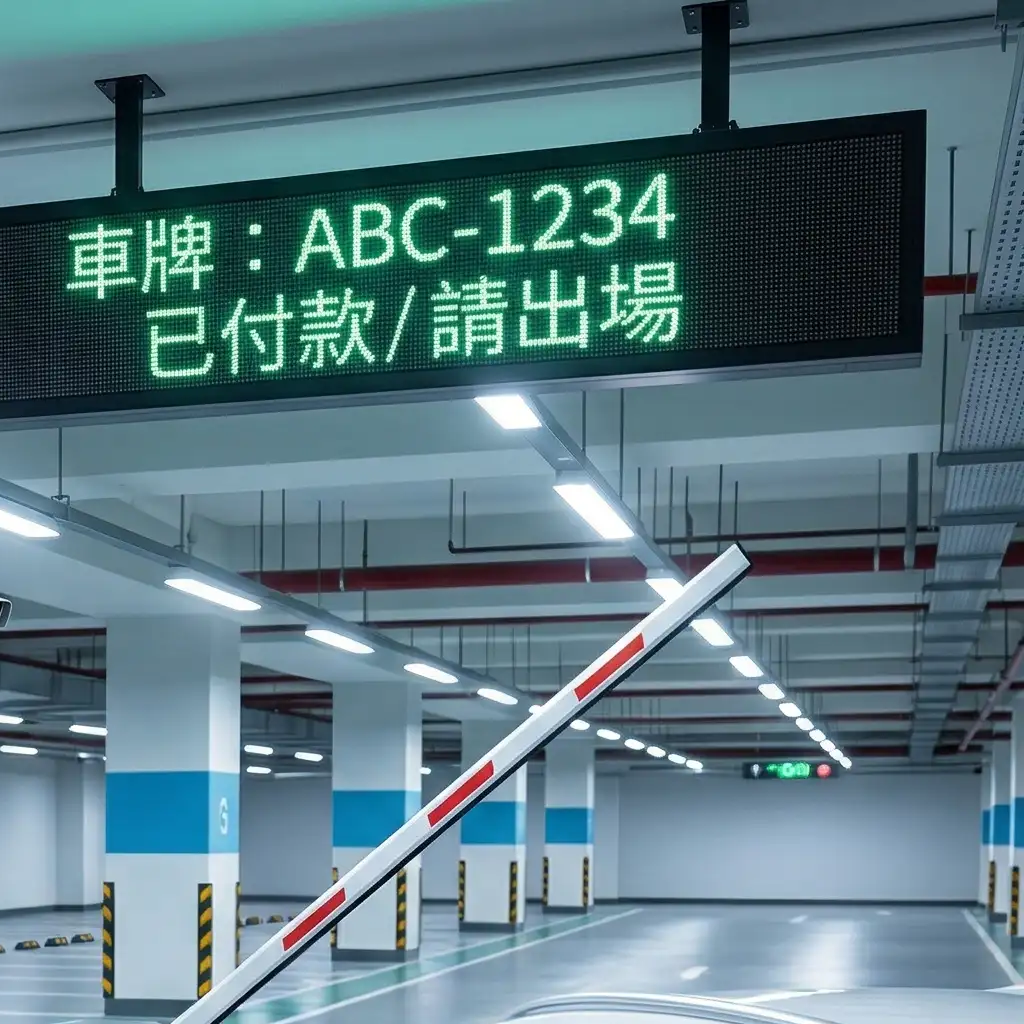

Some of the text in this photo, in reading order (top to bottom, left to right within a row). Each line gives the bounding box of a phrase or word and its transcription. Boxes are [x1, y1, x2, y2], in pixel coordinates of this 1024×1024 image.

[146, 260, 684, 379] 已付款/請出場
